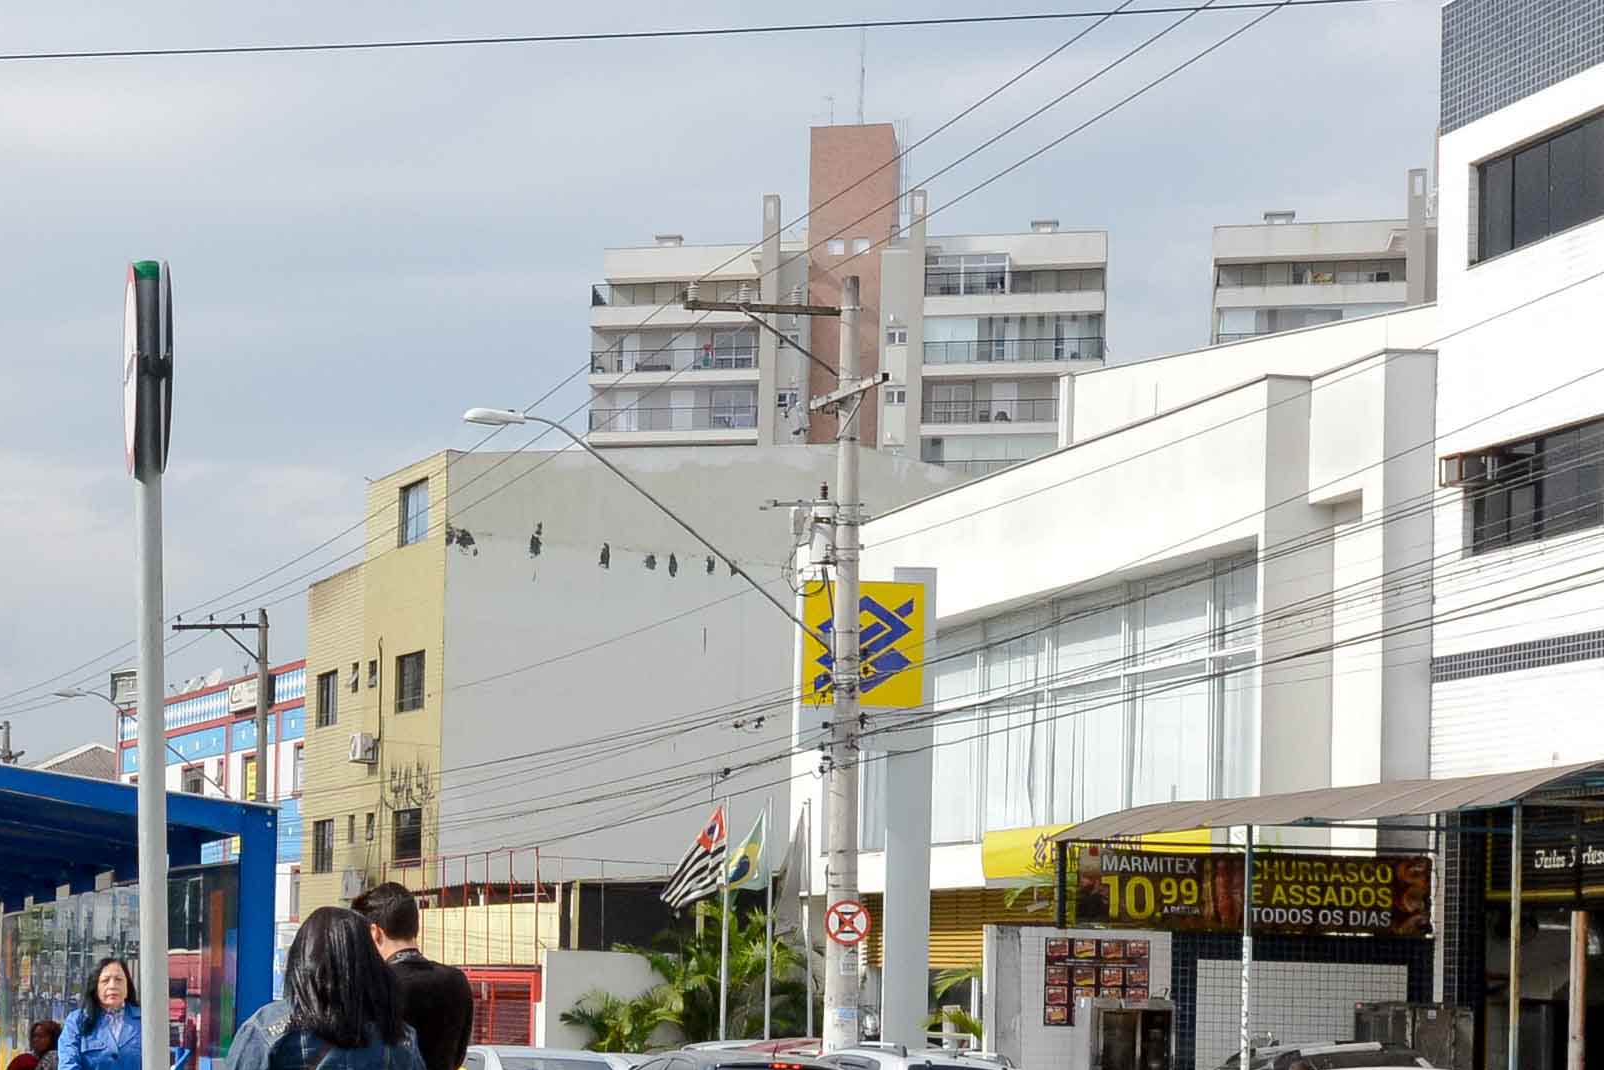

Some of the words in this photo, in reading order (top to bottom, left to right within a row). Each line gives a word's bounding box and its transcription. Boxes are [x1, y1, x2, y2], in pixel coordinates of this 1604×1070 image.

[1101, 855, 1197, 875] MARMITEX
[1252, 858, 1393, 884] CHURRASCO
[1271, 884, 1394, 909] ASSADOS
[1252, 907, 1314, 926] TODOS
[1318, 909, 1345, 927] OS
[1348, 910, 1392, 928] DIAS
